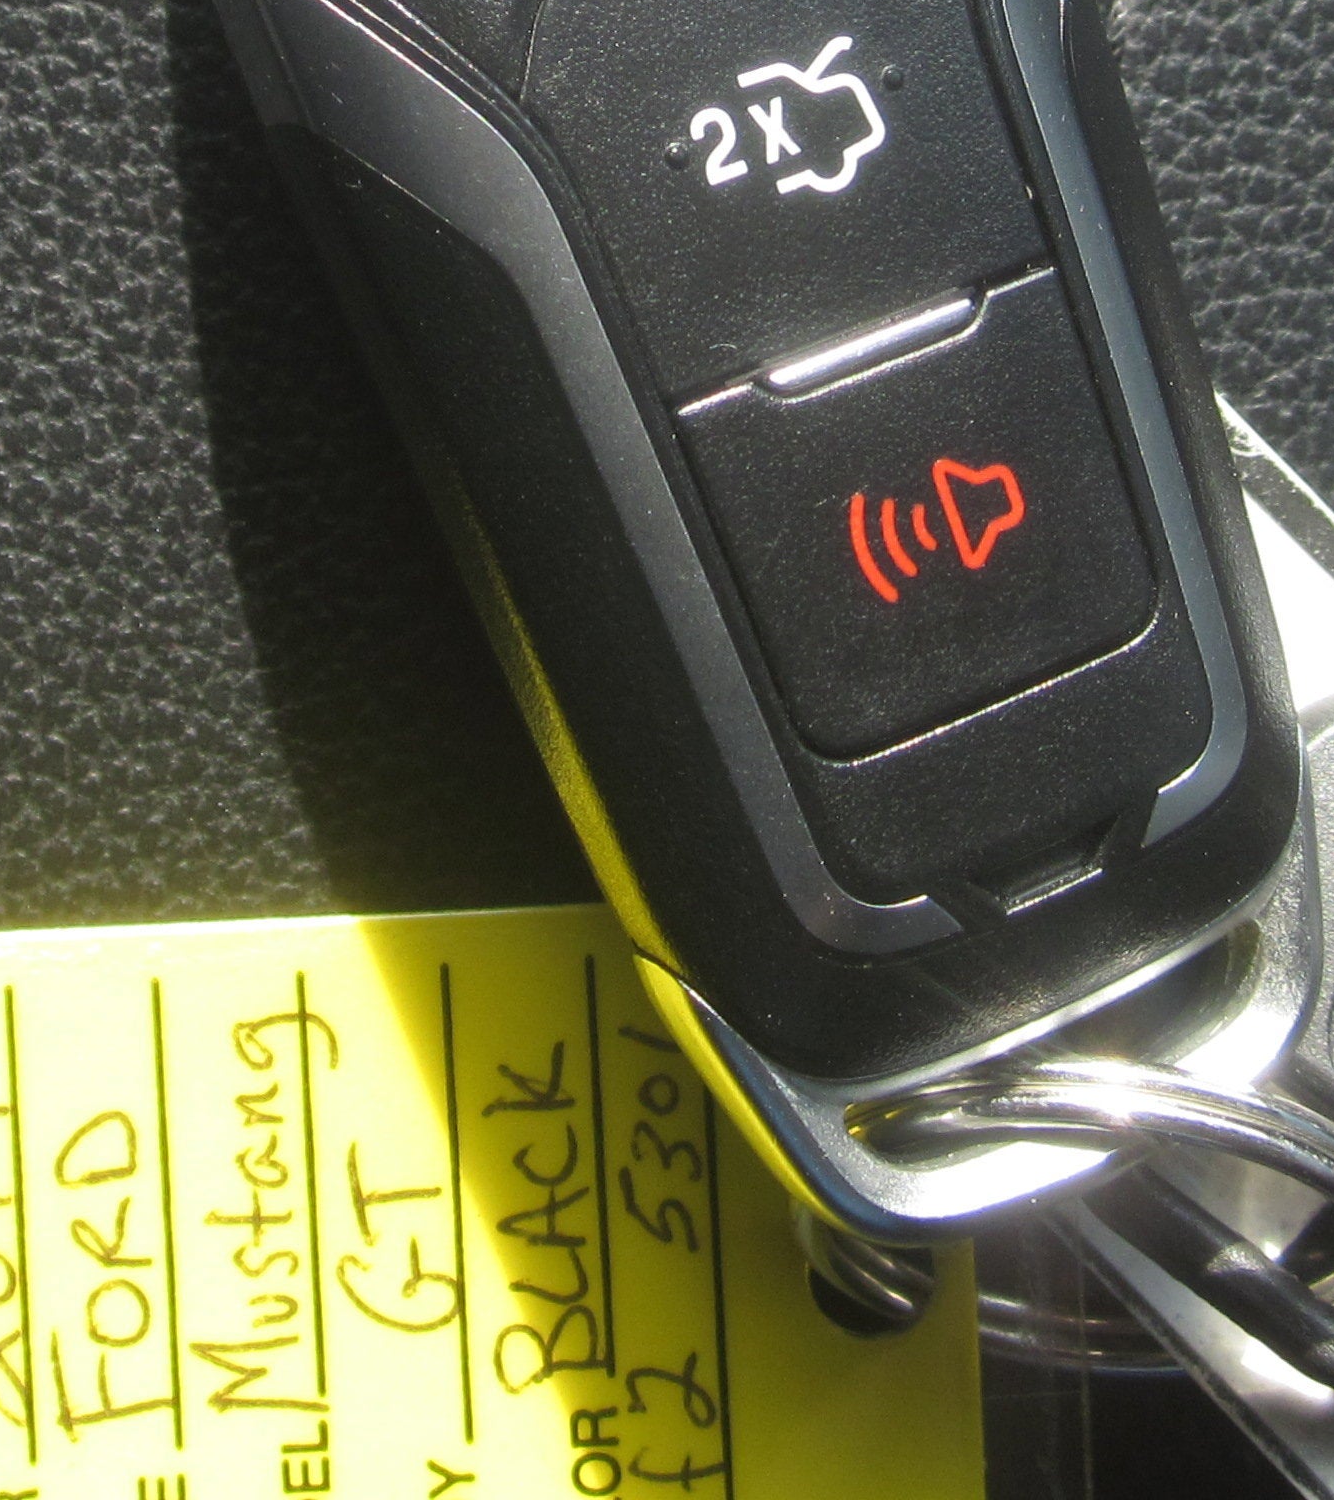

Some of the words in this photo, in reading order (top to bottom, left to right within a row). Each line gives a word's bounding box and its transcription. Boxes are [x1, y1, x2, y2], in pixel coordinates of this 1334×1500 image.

[53, 1111, 177, 1441] FORD
[189, 1012, 338, 1413] Mustang
[336, 1142, 460, 1332] GT
[482, 1040, 611, 1393] BLACK
[281, 1420, 331, 1500] EL
[570, 1405, 622, 1500] OR
